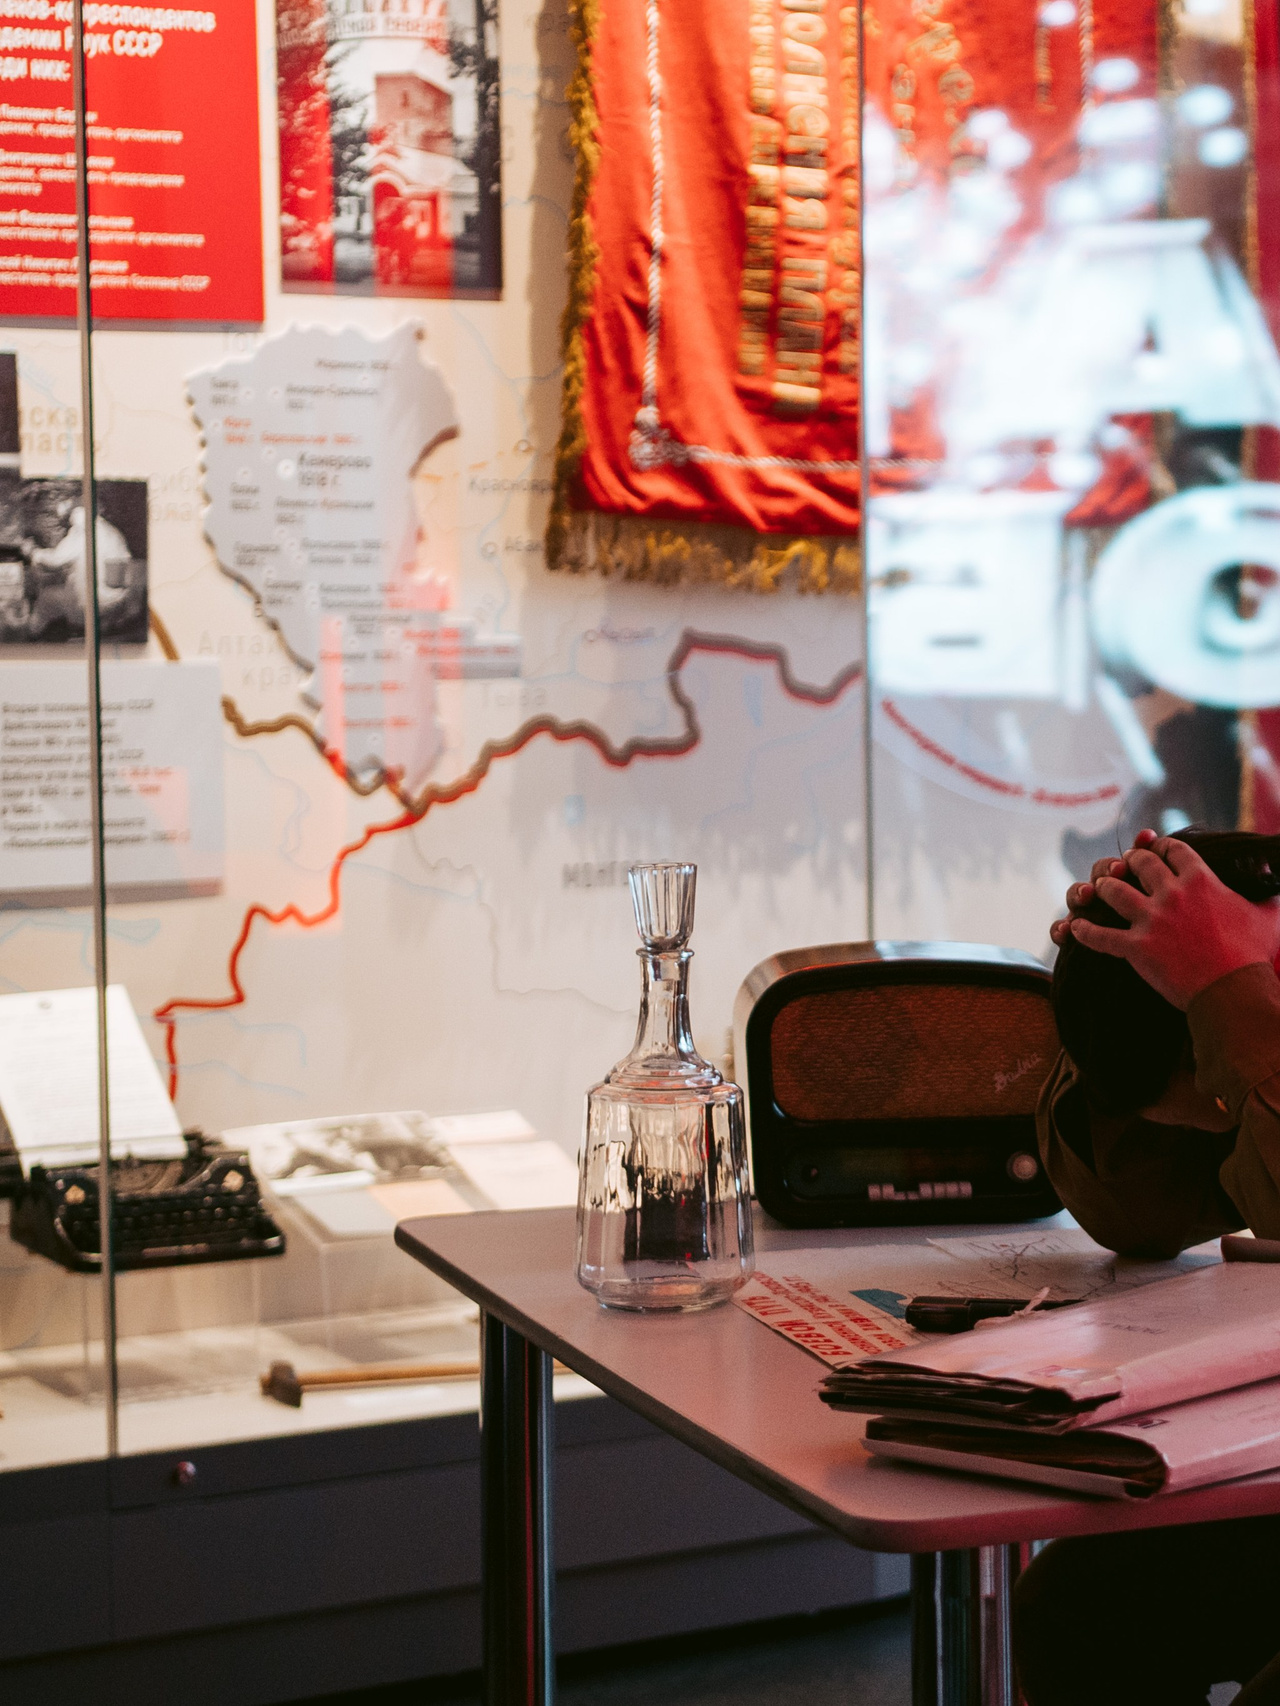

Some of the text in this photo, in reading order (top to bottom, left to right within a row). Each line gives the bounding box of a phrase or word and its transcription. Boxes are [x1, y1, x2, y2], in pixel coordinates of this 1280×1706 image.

[112, 29, 163, 57] СССР
[741, 1295, 853, 1356] БОЕВОЙ ПУТЬ
